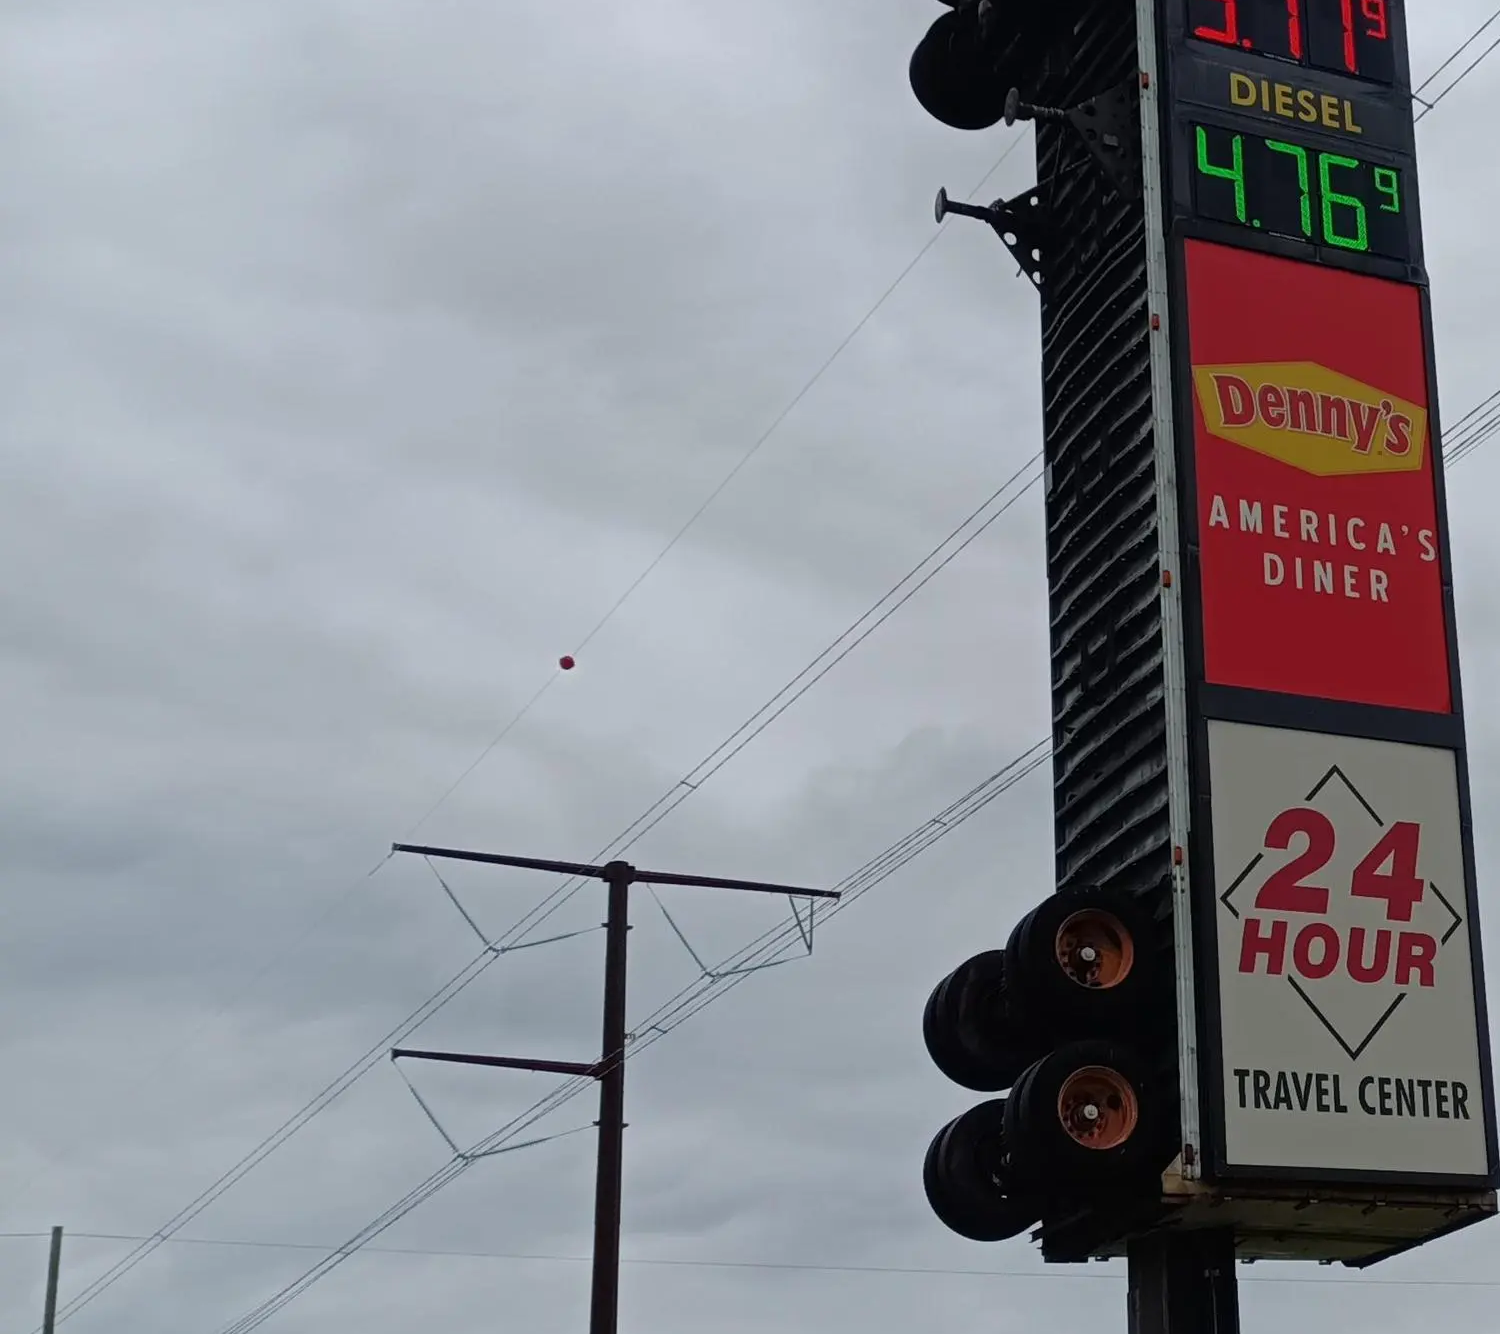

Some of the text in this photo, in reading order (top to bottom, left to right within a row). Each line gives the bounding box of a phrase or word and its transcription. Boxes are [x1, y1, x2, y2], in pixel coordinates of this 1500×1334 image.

[1230, 73, 1362, 134] DIESEL
[1210, 372, 1413, 456] Denny's
[1208, 494, 1437, 561] AMERICA'S
[1263, 552, 1390, 602] DINER
[1255, 807, 1425, 922] 24
[1238, 917, 1438, 987] HOUR
[1233, 1068, 1471, 1121] TRAVEL CENTER
